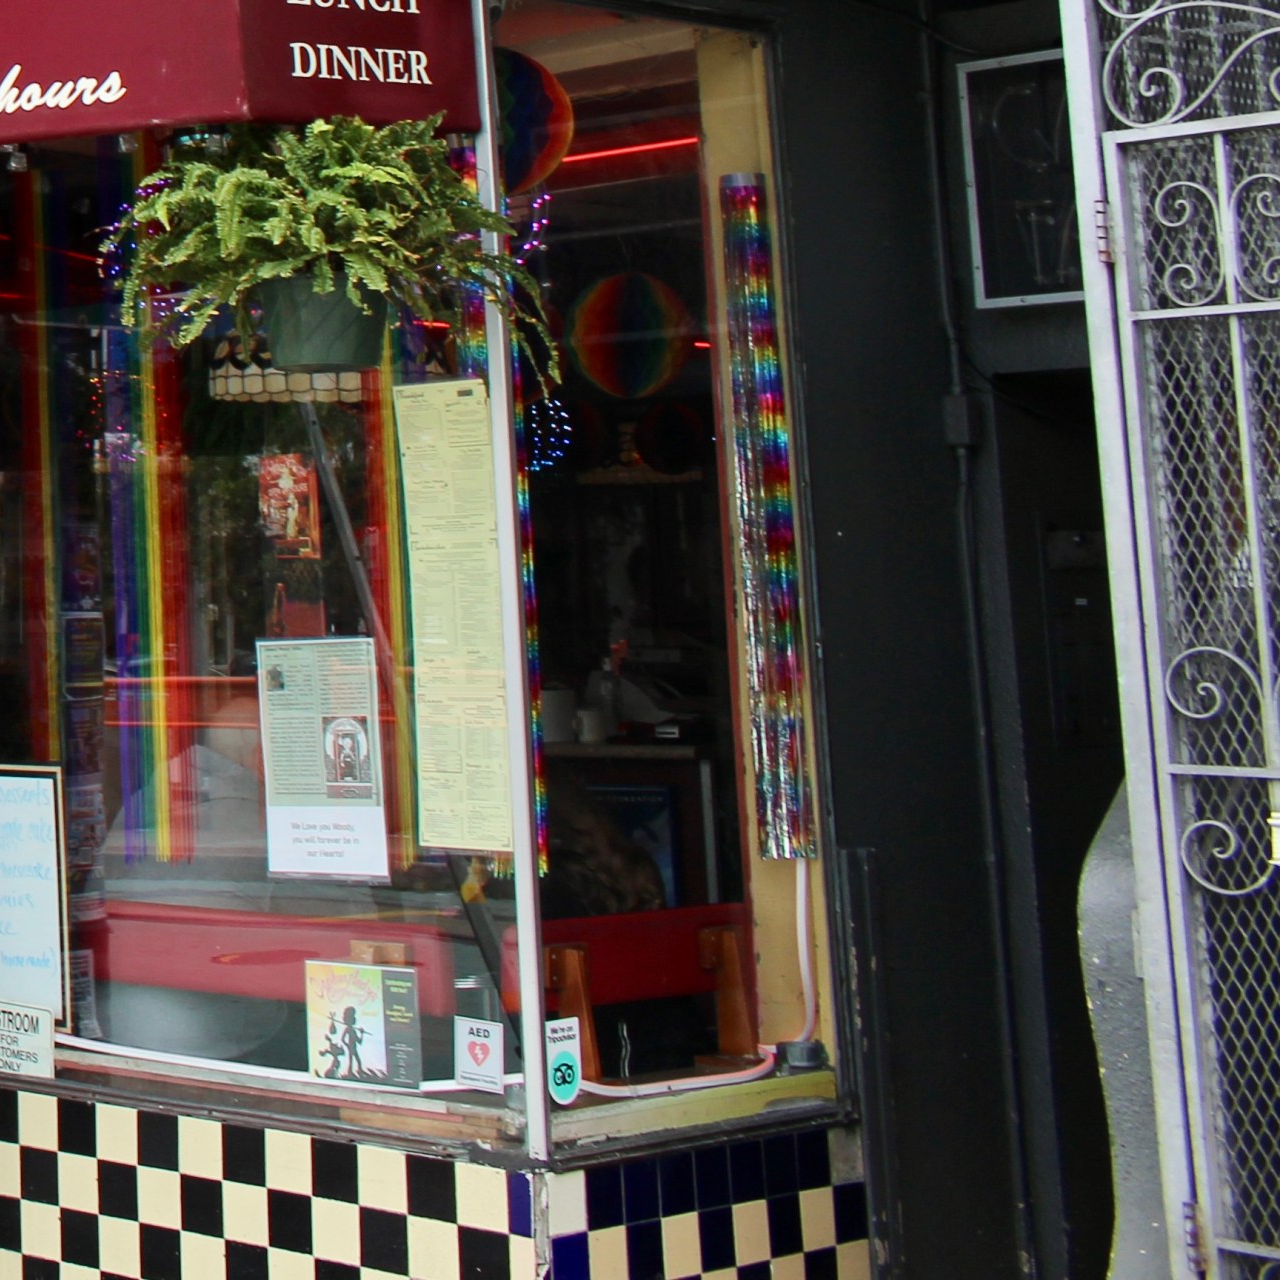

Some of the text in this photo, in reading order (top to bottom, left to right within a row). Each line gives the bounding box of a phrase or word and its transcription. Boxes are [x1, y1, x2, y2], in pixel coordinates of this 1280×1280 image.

[290, 41, 433, 86] DINNER
[319, 823, 331, 832] you
[468, 1026, 491, 1039] AED
[0, 1034, 19, 1046] FOR
